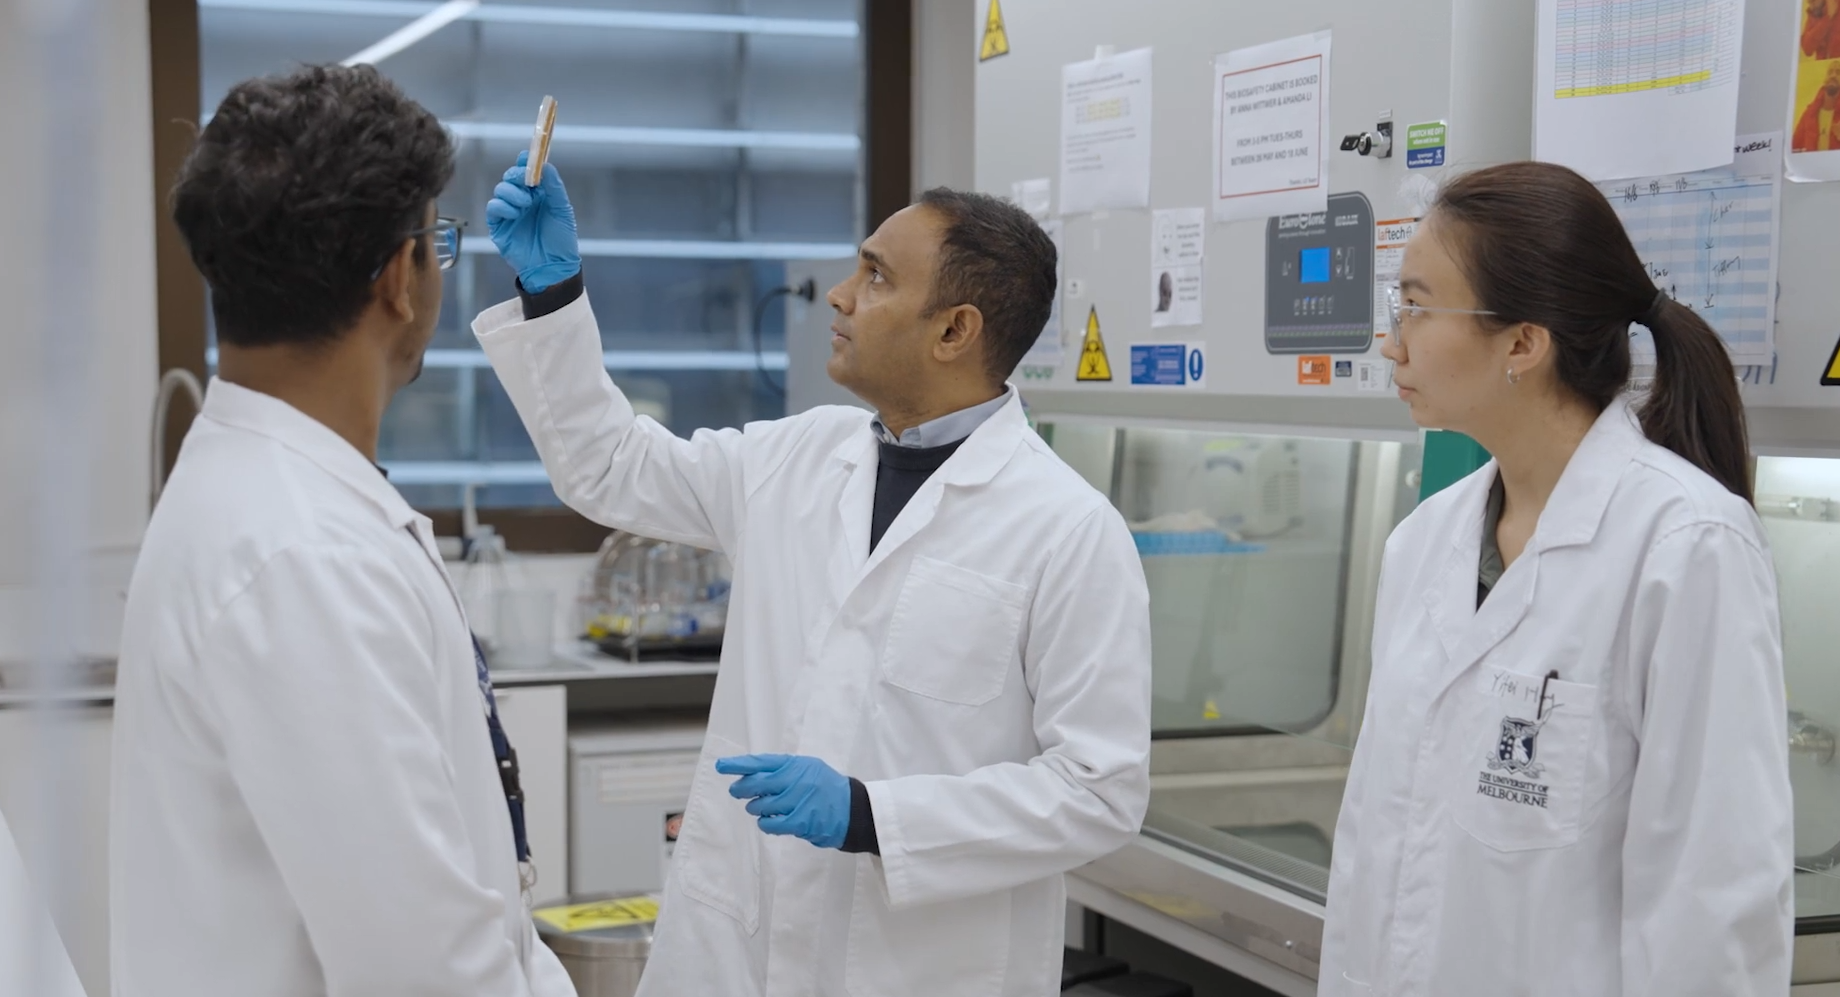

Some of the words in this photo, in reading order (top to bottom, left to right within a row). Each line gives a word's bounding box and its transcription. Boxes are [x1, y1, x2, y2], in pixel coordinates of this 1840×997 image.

[1225, 90, 1236, 99] THIS
[1238, 85, 1264, 98] BIOSAFETY
[1265, 80, 1288, 93] CABINET
[1289, 80, 1294, 88] IS
[1295, 75, 1318, 87] BOOKED
[1230, 106, 1236, 114] BY
[1238, 103, 1251, 113] ANNA
[1283, 93, 1305, 105] AMANDA
[1237, 138, 1251, 147] FROM
[1261, 135, 1268, 143] PM
[1231, 154, 1255, 166] BETWEEN
[1263, 152, 1274, 161] MAY
[1275, 150, 1286, 160] AND
[1294, 147, 1308, 157] JUNE
[1480, 771, 1491, 781] THE
[1492, 775, 1537, 791] UNIVERSITY
[1538, 784, 1549, 793] OF
[1477, 784, 1548, 809] MELBOURNE
